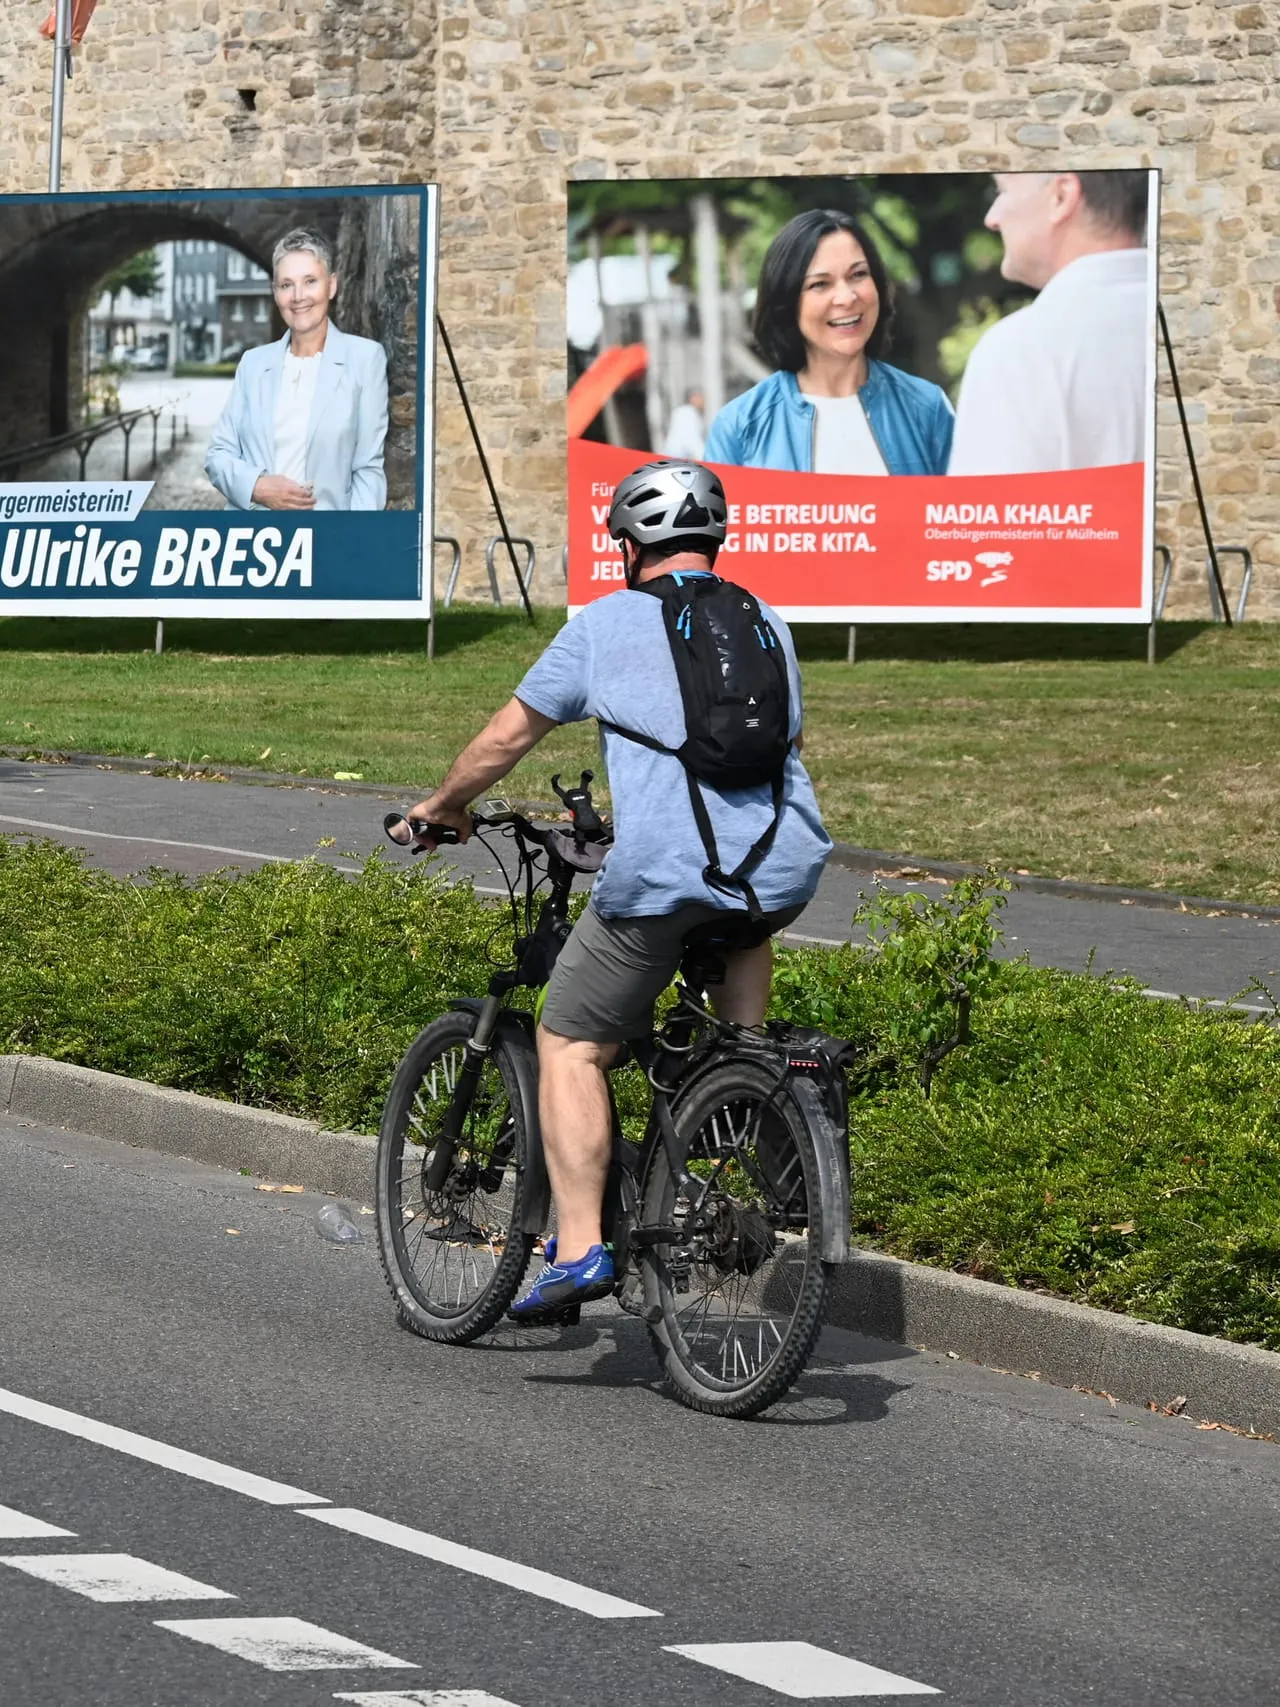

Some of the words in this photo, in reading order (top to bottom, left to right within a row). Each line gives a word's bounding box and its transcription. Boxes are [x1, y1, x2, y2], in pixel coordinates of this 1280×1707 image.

[591, 482, 617, 497] Für
[745, 504, 877, 524] BETREUUNG
[925, 504, 1000, 524] NADIA
[1004, 504, 1093, 524] KHALAF
[745, 532, 770, 552] IN
[774, 532, 817, 552] DER
[821, 532, 877, 552] KITA.
[924, 527, 1044, 543] Oberbürgermeisterin
[1046, 527, 1064, 540] für
[1066, 527, 1119, 540] Mülheim
[0, 524, 142, 588] Ulrike
[151, 526, 314, 587] BRESA
[925, 560, 973, 581] SPD
